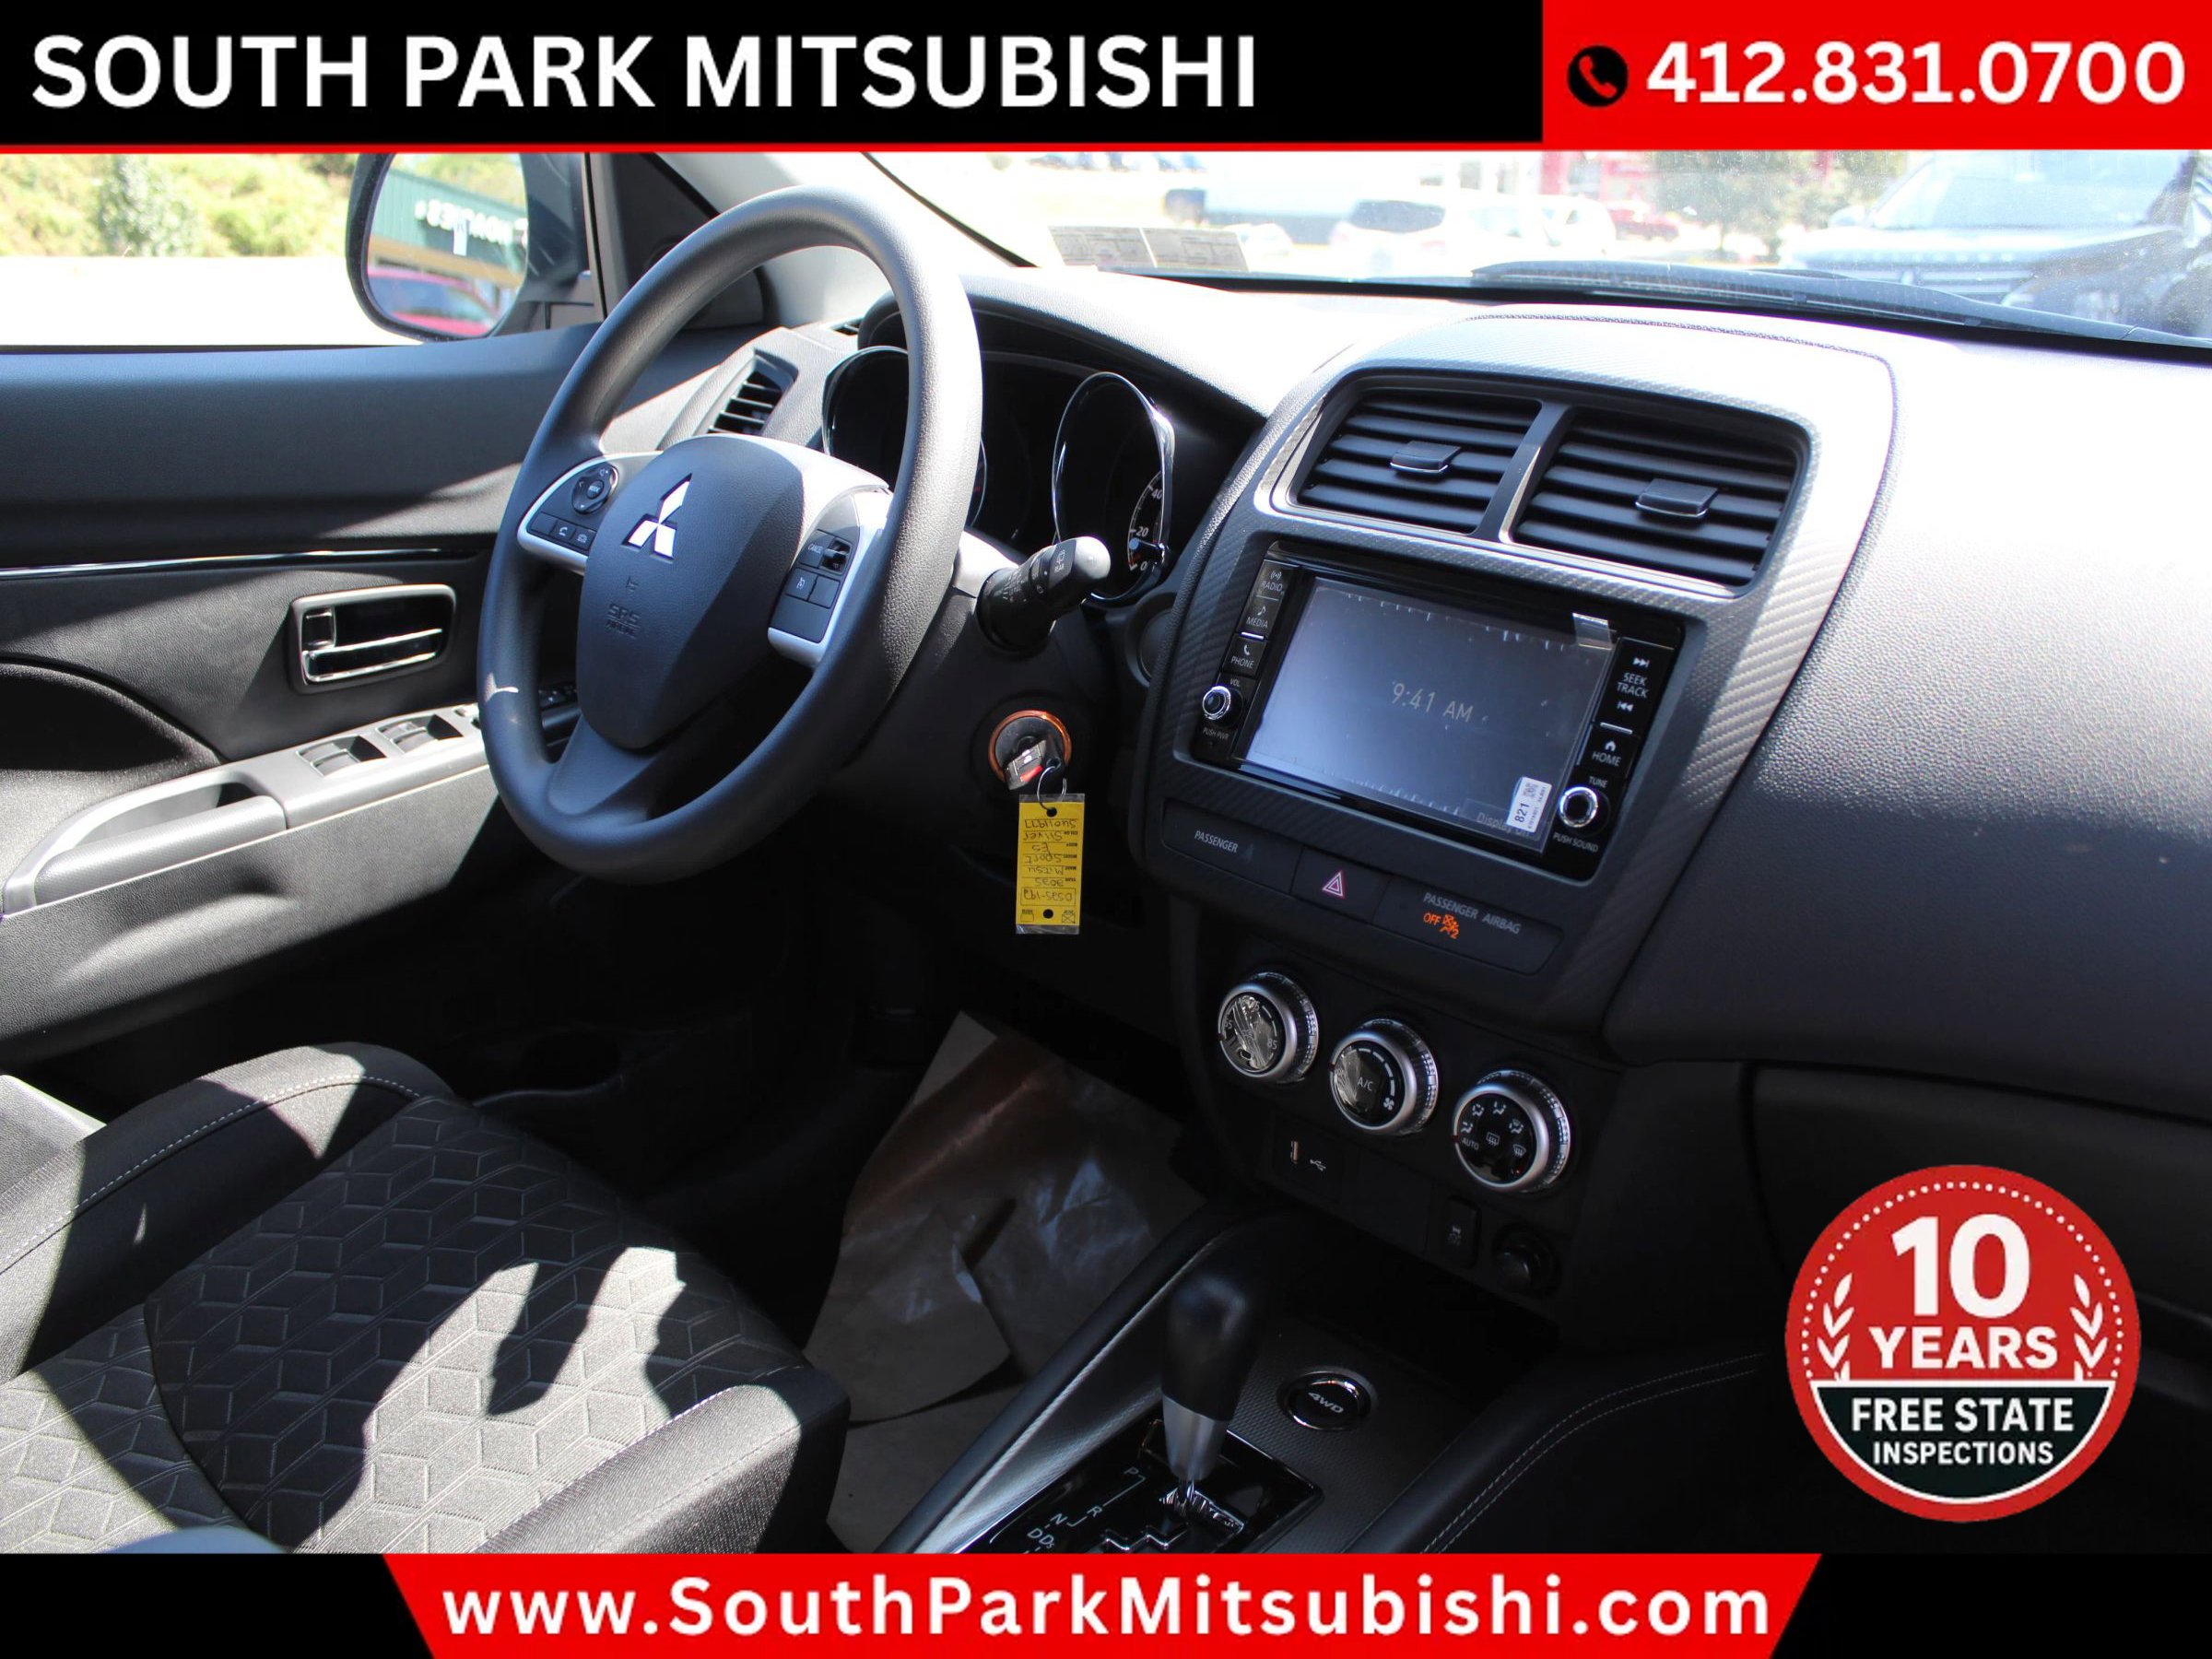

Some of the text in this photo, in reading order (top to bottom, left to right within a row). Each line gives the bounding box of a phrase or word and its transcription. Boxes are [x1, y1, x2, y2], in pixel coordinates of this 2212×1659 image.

[1151, 488, 1162, 500] 40
[1136, 526, 1149, 536] 20
[1140, 561, 1147, 571] 0
[1261, 580, 1283, 592] RADIO
[1246, 616, 1268, 629] MEDIA
[1230, 655, 1254, 669] PHONE
[1230, 677, 1241, 688] VOL
[1623, 672, 1648, 687] SEEK
[1618, 681, 1648, 698] TRACK
[1392, 683, 1474, 723] 9:41 AM
[1592, 750, 1622, 767] HOME
[1588, 775, 1608, 789] TUNE
[1514, 802, 1530, 823] 821
[1194, 830, 1239, 853] PASSENGER
[1552, 832, 1599, 853] PUSH SOUND
[1422, 892, 1521, 935] PASSENGER AIRBAG
[1423, 912, 1442, 926] OFF
[1266, 1038, 1278, 1050] 85
[1357, 1077, 1373, 1092] A/C
[1462, 1136, 1480, 1151] AUTO
[1124, 1466, 1139, 1475] P
[1086, 1505, 1103, 1518] R
[1049, 1513, 1068, 1525] N
